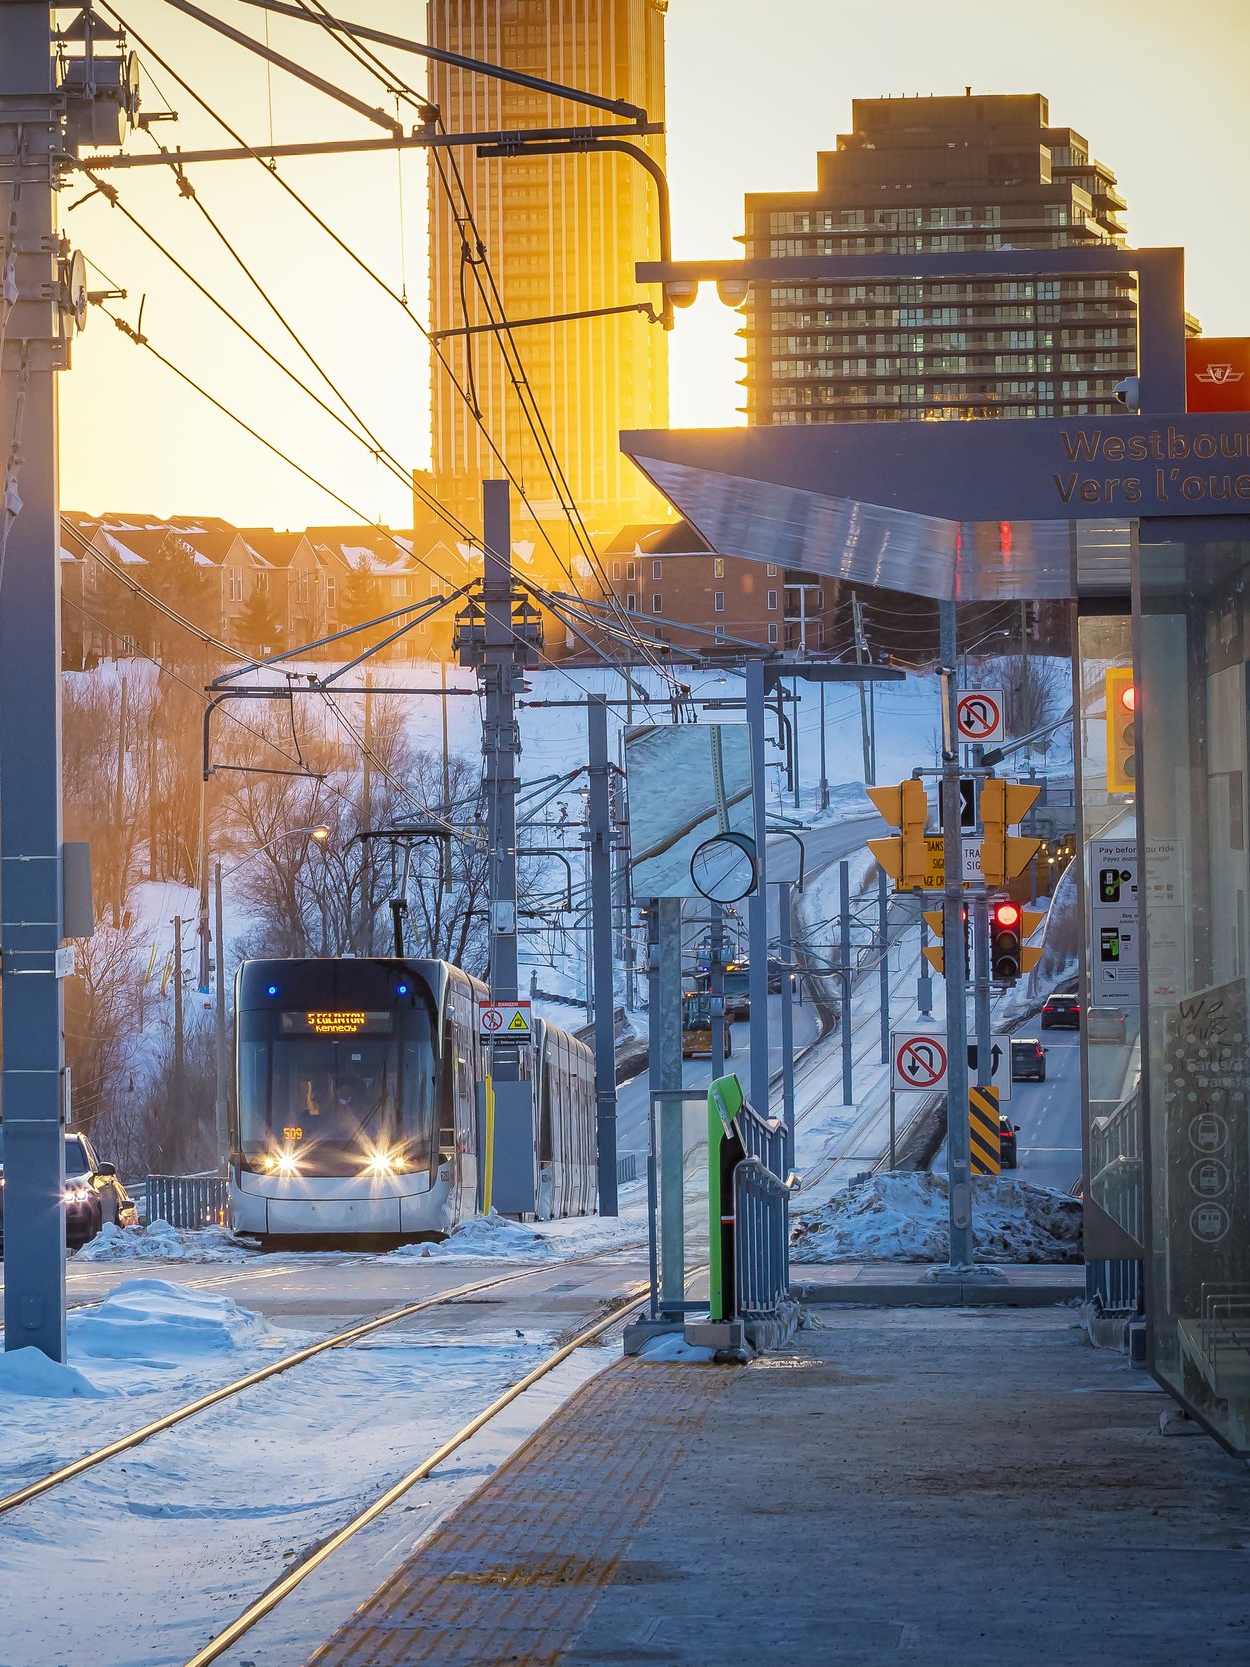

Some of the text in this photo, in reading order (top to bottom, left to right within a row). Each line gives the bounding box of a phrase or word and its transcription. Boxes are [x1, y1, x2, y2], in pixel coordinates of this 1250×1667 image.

[1060, 427, 1250, 462] Westbou
[1053, 473, 1142, 504] Vers
[1099, 847, 1114, 855] Pay
[1115, 846, 1137, 854] befor
[1158, 845, 1175, 853] ride
[308, 1013, 365, 1024] 5 EGLINTON
